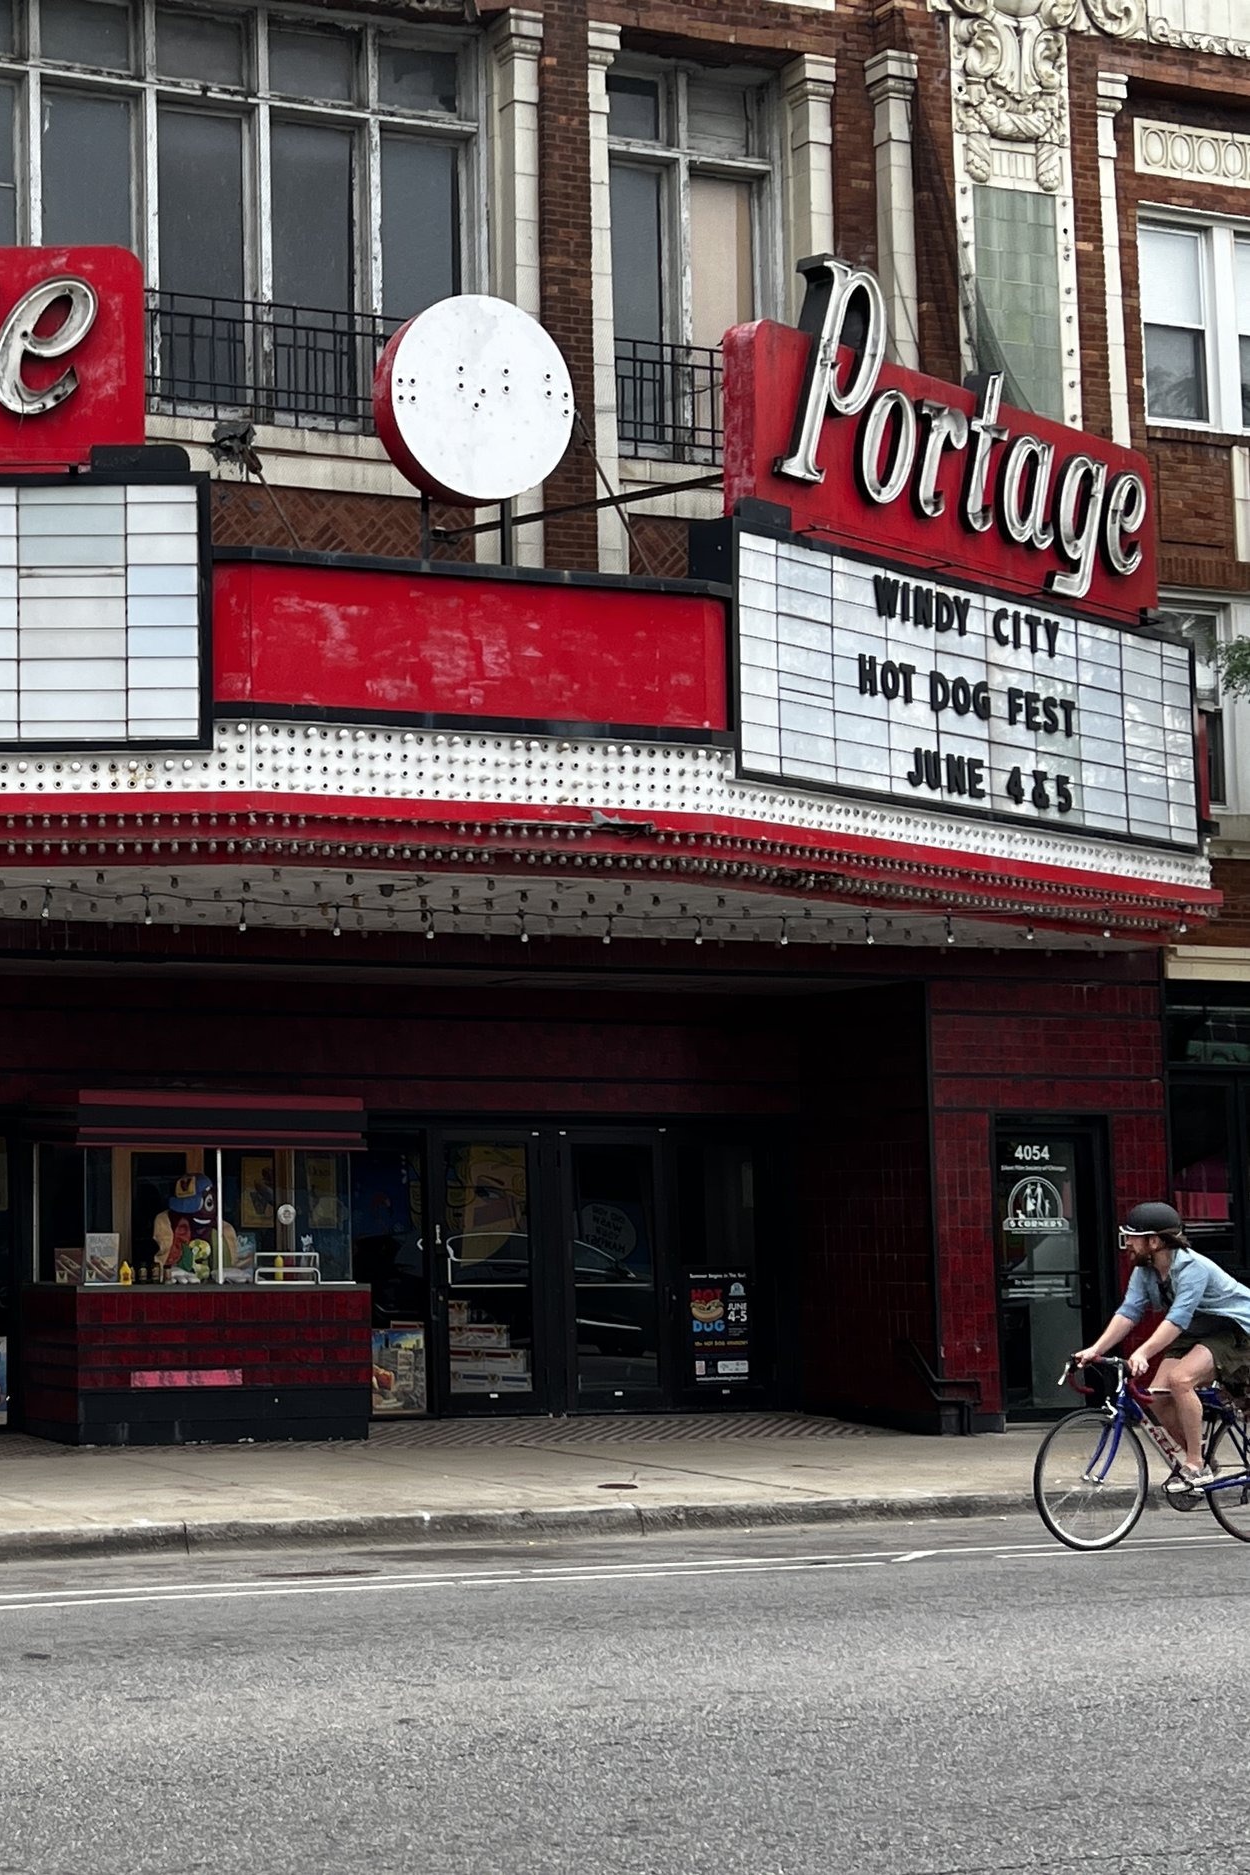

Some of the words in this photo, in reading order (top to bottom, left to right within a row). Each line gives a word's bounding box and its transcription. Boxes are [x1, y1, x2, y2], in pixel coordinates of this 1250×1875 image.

[773, 253, 1148, 598] Portage
[873, 574, 971, 636] WINDY
[993, 608, 1060, 658] CITY
[858, 653, 916, 704] HOT
[930, 670, 991, 721] DOG
[1008, 687, 1076, 738] FEST
[907, 747, 986, 799] JUNE
[1014, 1144, 1050, 1161] 4054
[1017, 1220, 1063, 1228] CORNERS
[690, 1287, 724, 1301] HOT
[727, 1302, 748, 1311] JUNE
[727, 1310, 748, 1322] 4-5
[692, 1319, 726, 1333] DOG
